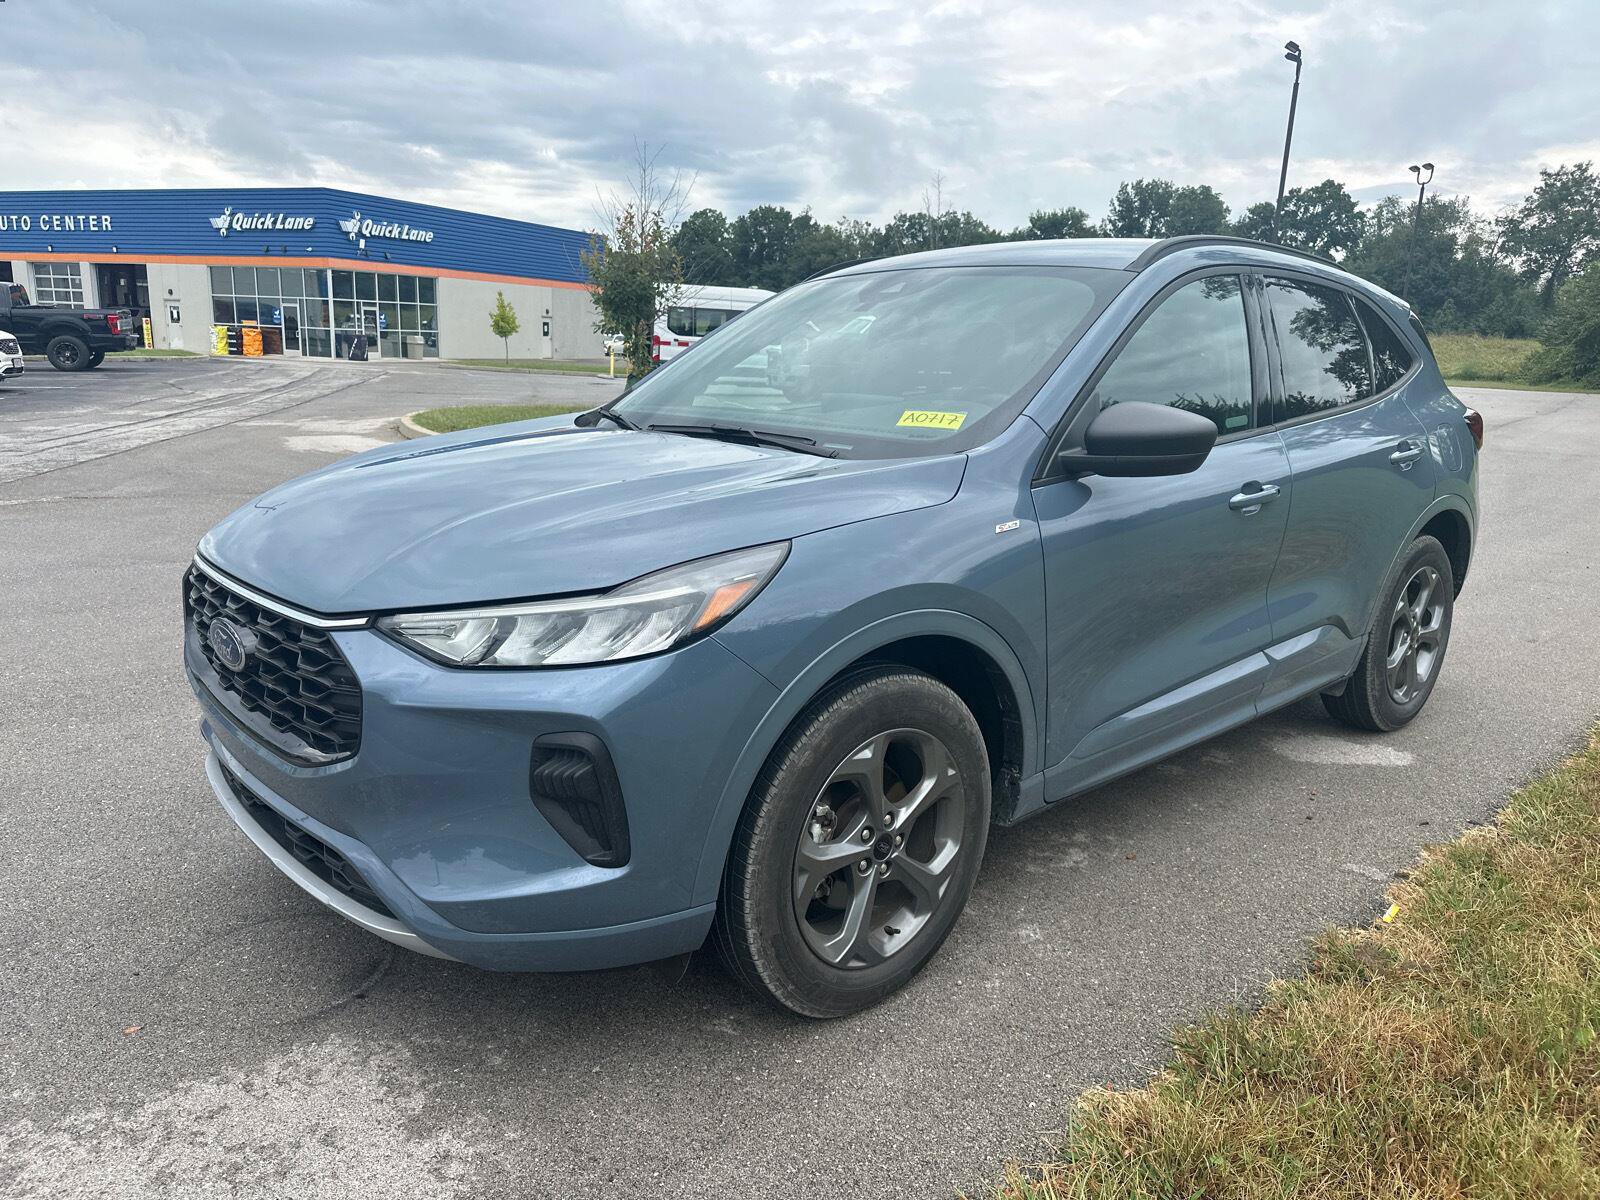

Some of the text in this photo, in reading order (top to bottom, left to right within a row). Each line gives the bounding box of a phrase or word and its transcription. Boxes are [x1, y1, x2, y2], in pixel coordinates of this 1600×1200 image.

[40, 214, 112, 231] CENTER
[232, 212, 314, 231] Quick Lane
[361, 219, 434, 242] Quick Lane
